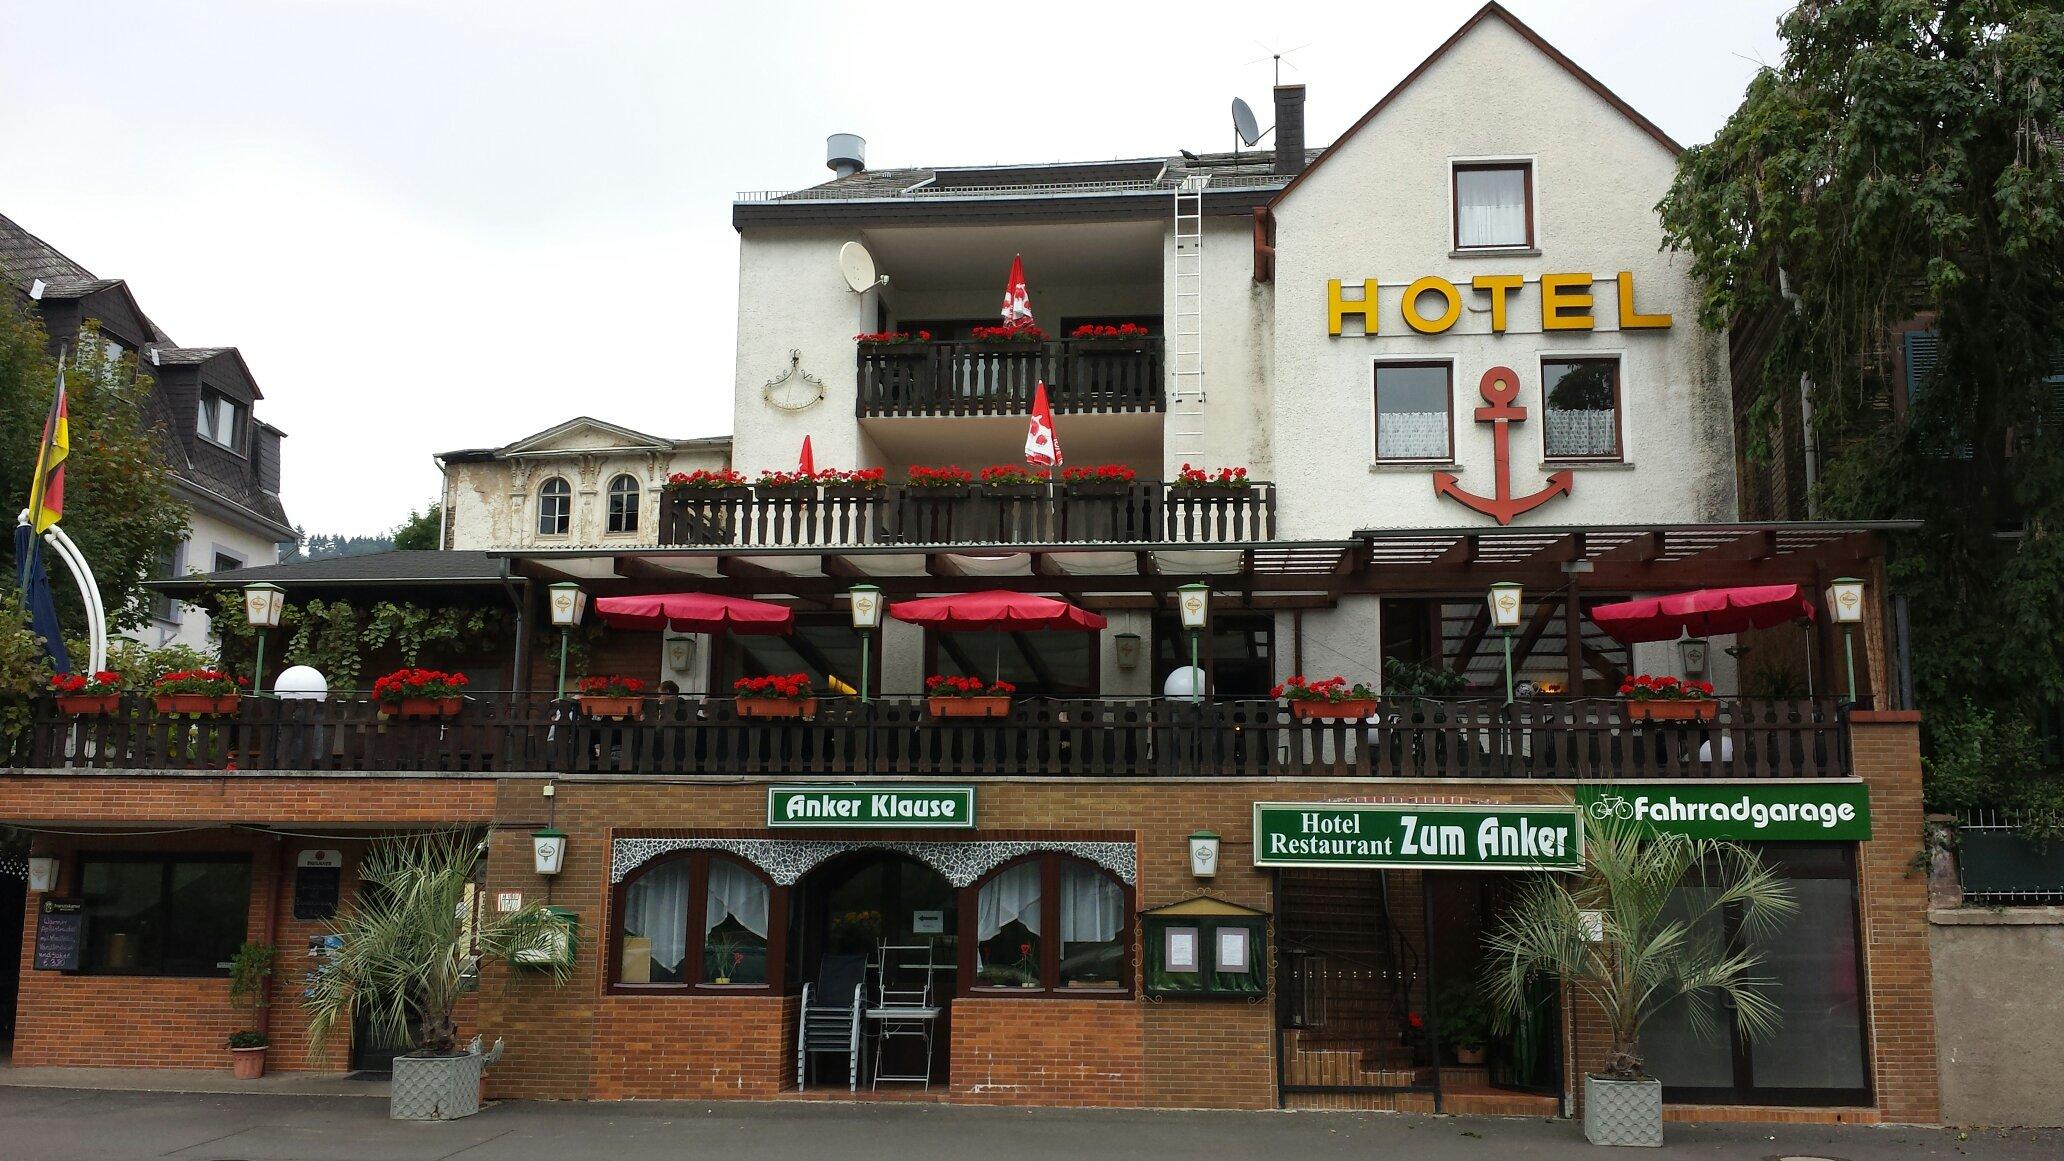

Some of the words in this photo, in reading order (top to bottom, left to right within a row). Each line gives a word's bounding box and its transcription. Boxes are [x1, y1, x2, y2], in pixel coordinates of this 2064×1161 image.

[1327, 271, 1673, 336] HOTEL
[786, 794, 862, 819] Anker
[871, 794, 956, 818] Klause
[1634, 795, 1856, 829] Fahrradgarage
[1300, 812, 1361, 834] Hotel
[1400, 815, 1466, 856] Zum
[1477, 816, 1569, 860] Anker
[1269, 833, 1393, 856] Restaurant
